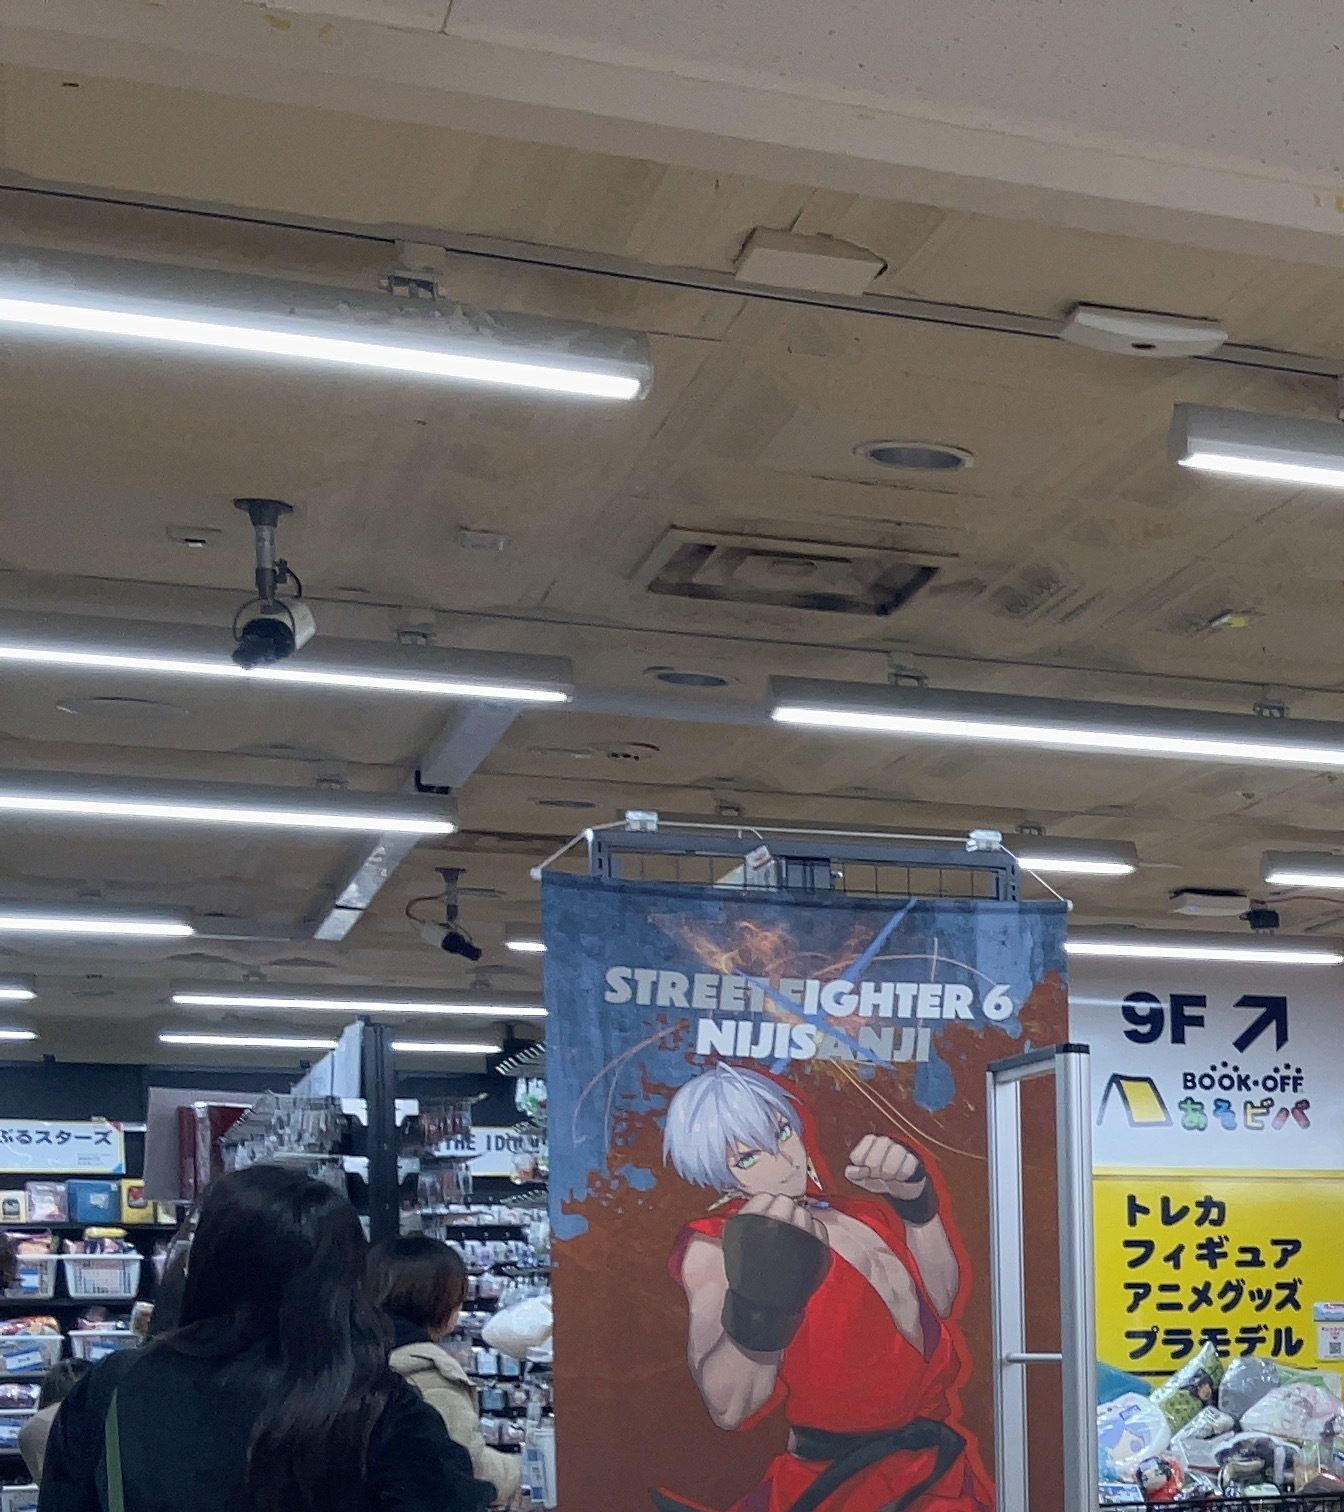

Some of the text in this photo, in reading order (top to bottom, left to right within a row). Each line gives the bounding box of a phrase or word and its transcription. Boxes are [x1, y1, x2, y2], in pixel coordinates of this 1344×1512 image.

[982, 984, 1015, 1022] 6
[1121, 991, 1207, 1044] 9F
[696, 1017, 932, 1063] NIJISANJI
[1178, 1096, 1312, 1131] あそビバ
[1126, 1193, 1226, 1228] トレカ
[1122, 1235, 1302, 1270] フィギュア
[1123, 1277, 1303, 1313] アニメグッズ
[1124, 1323, 1304, 1360] プラモデル
